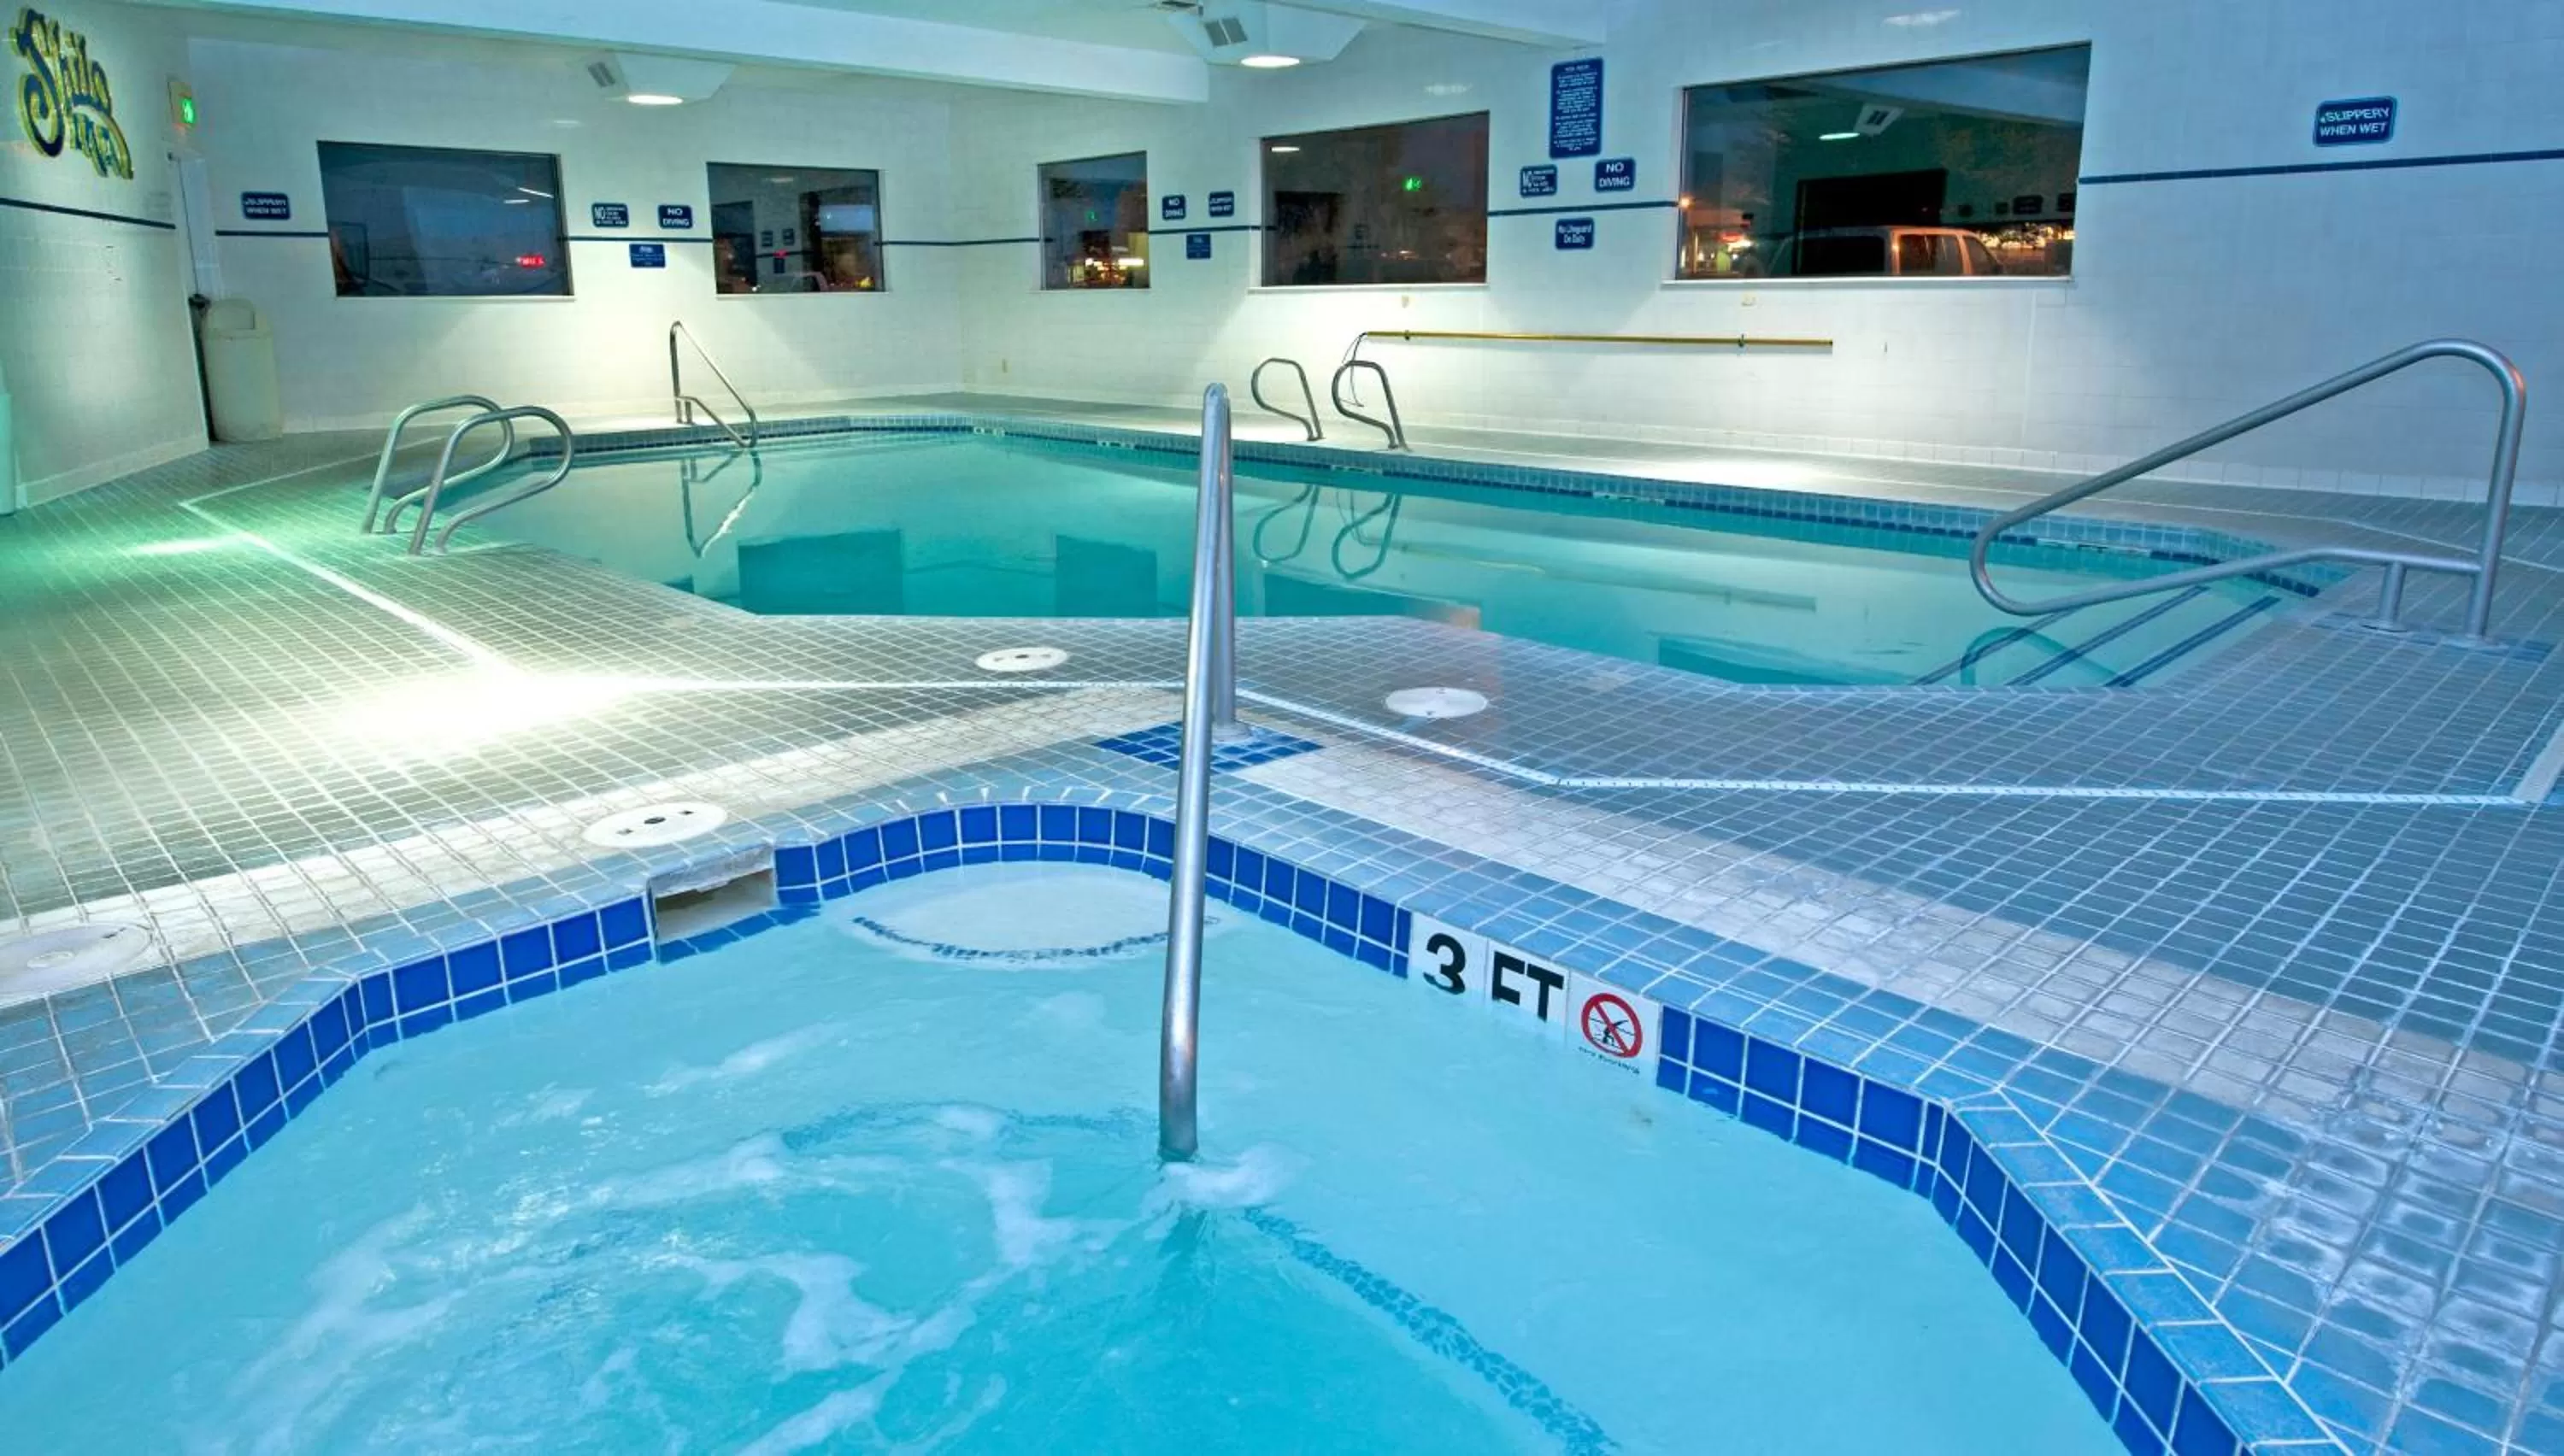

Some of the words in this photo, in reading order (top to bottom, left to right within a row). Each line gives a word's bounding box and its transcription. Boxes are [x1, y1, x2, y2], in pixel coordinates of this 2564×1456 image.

[2320, 124, 2356, 137] WHEN
[2360, 122, 2387, 134] WET
[1606, 162, 1625, 173] NO
[1599, 176, 1630, 187] DIVING
[662, 218, 690, 226] DIVING
[1423, 932, 1467, 995] 3
[1491, 950, 1565, 1024] FT
